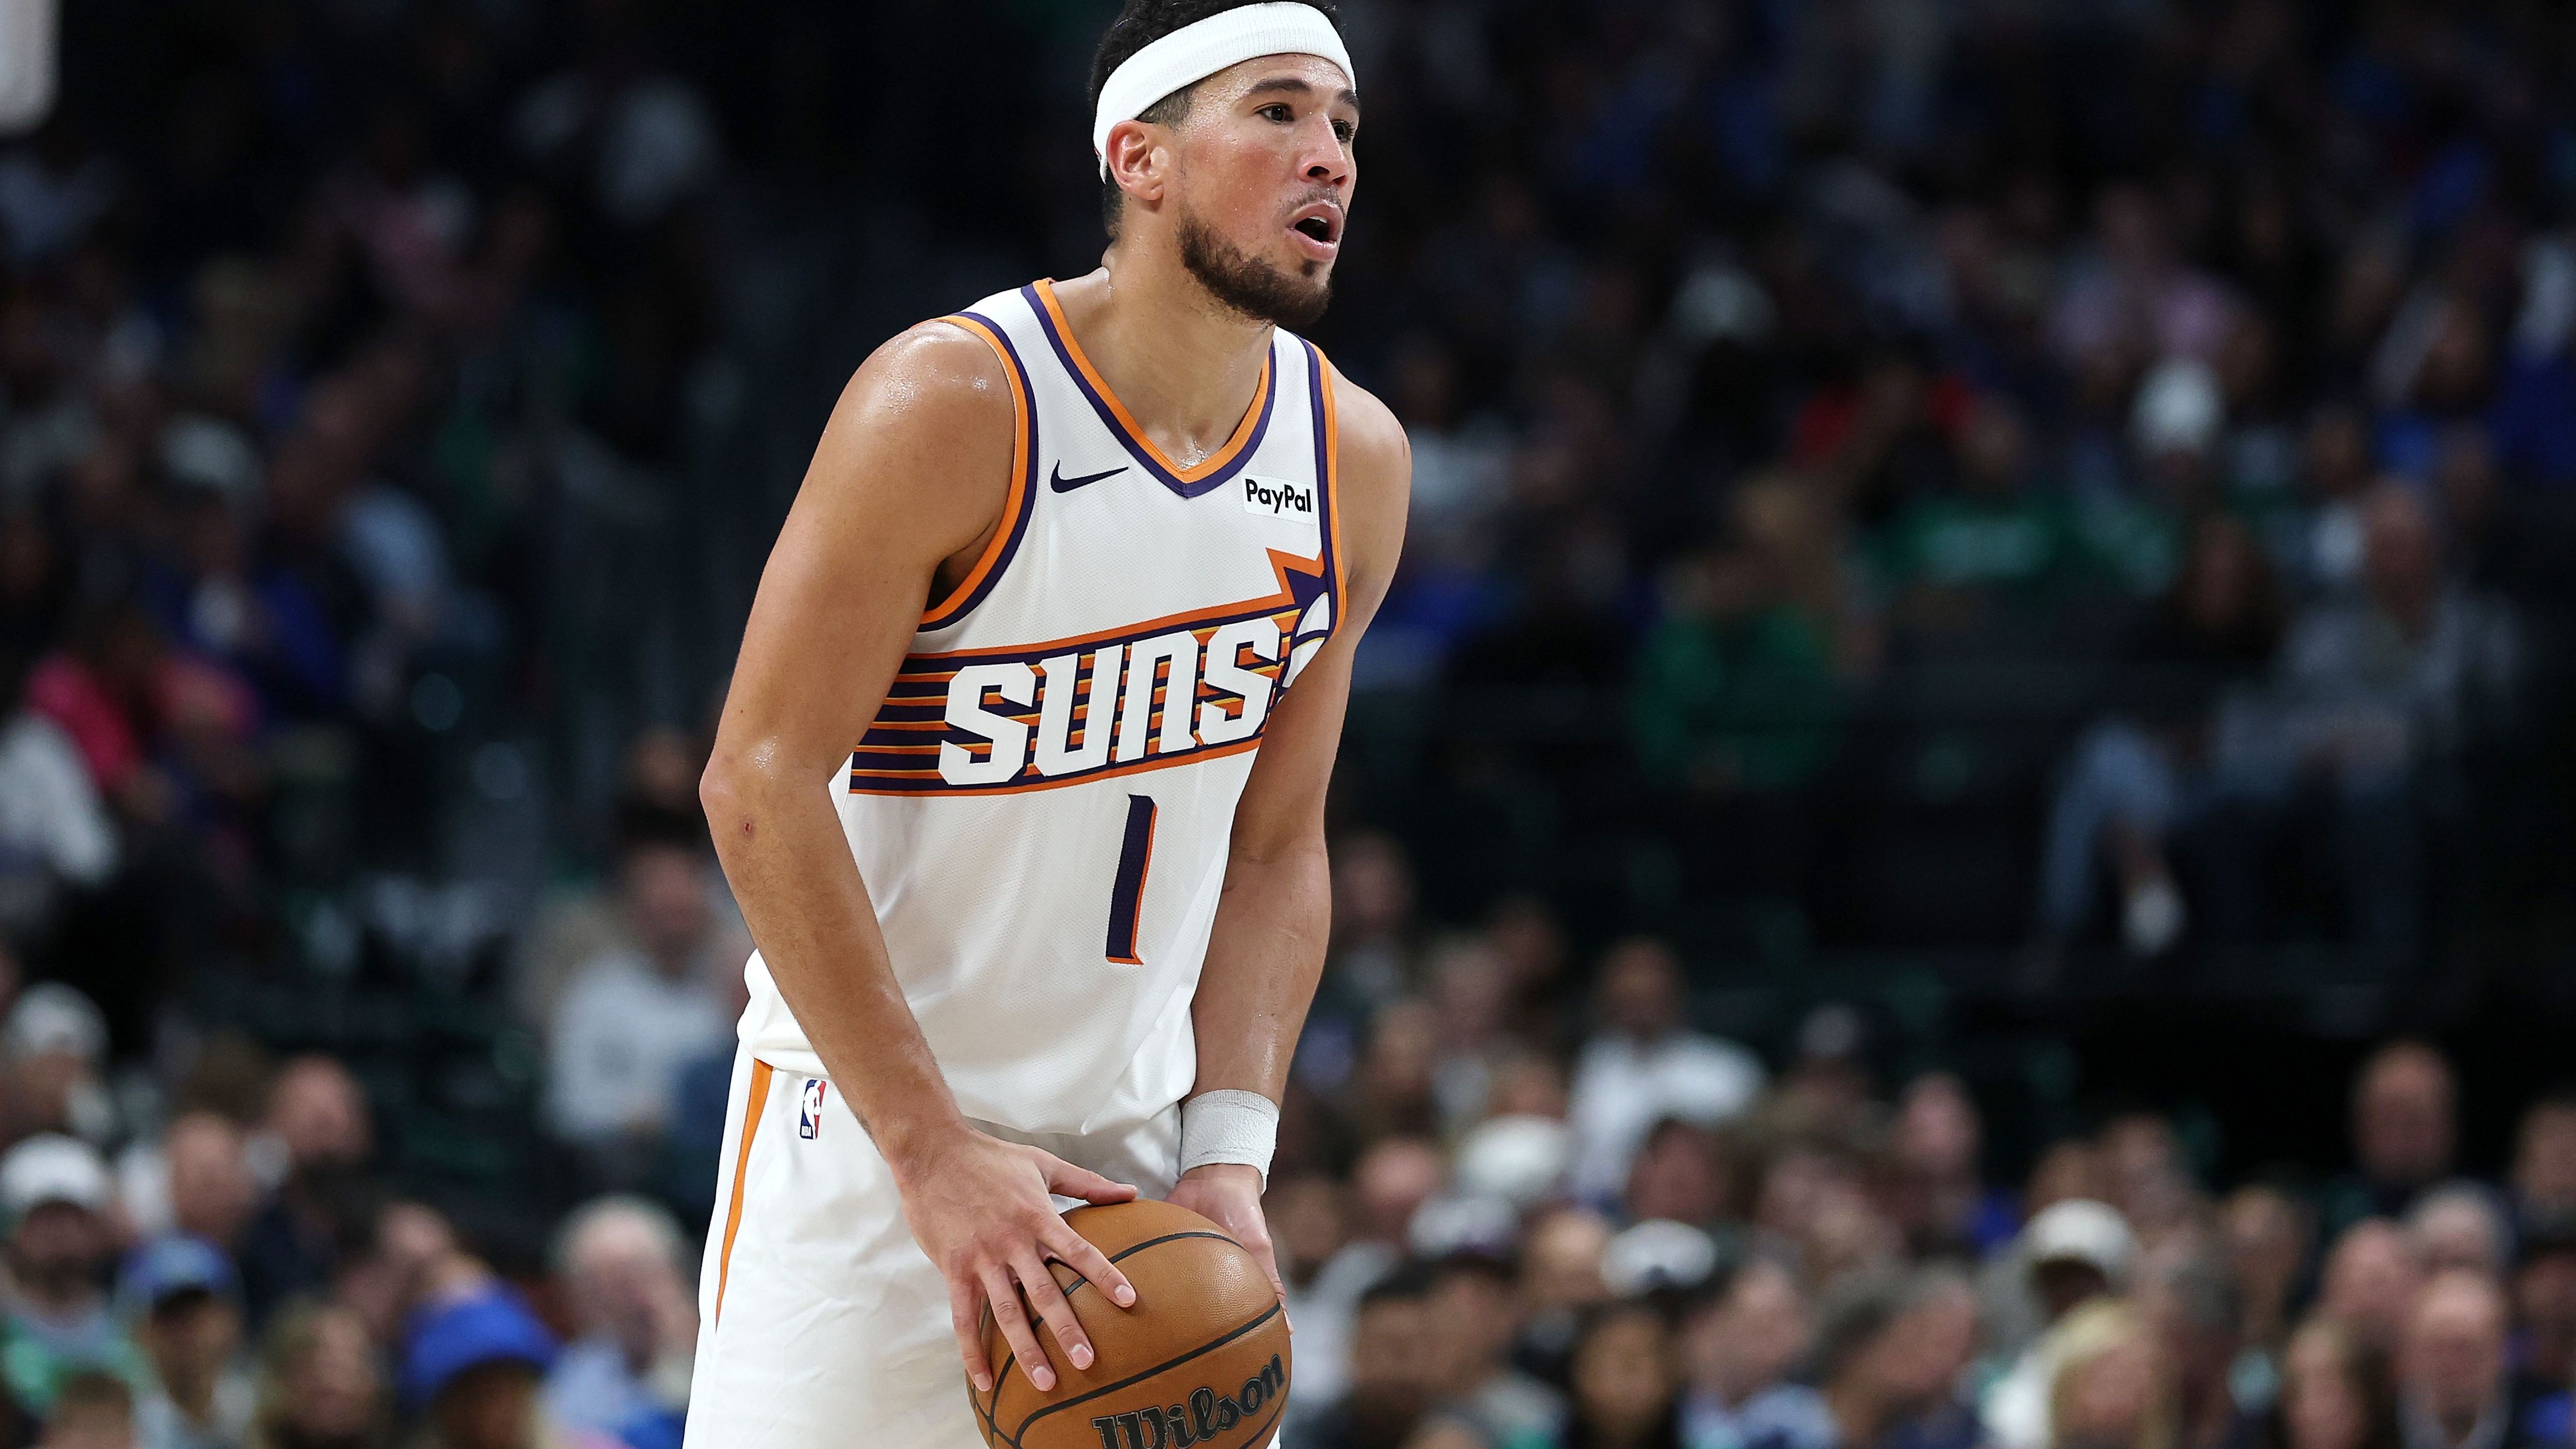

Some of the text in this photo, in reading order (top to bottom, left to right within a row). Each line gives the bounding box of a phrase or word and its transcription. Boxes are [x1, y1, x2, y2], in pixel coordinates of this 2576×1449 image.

[1245, 478, 1312, 514] PayPal
[937, 617, 1281, 785] SUNS
[1105, 794, 1158, 966] 1
[801, 1125, 812, 1137] NBA
[1091, 1353, 1285, 1449] Wilson
